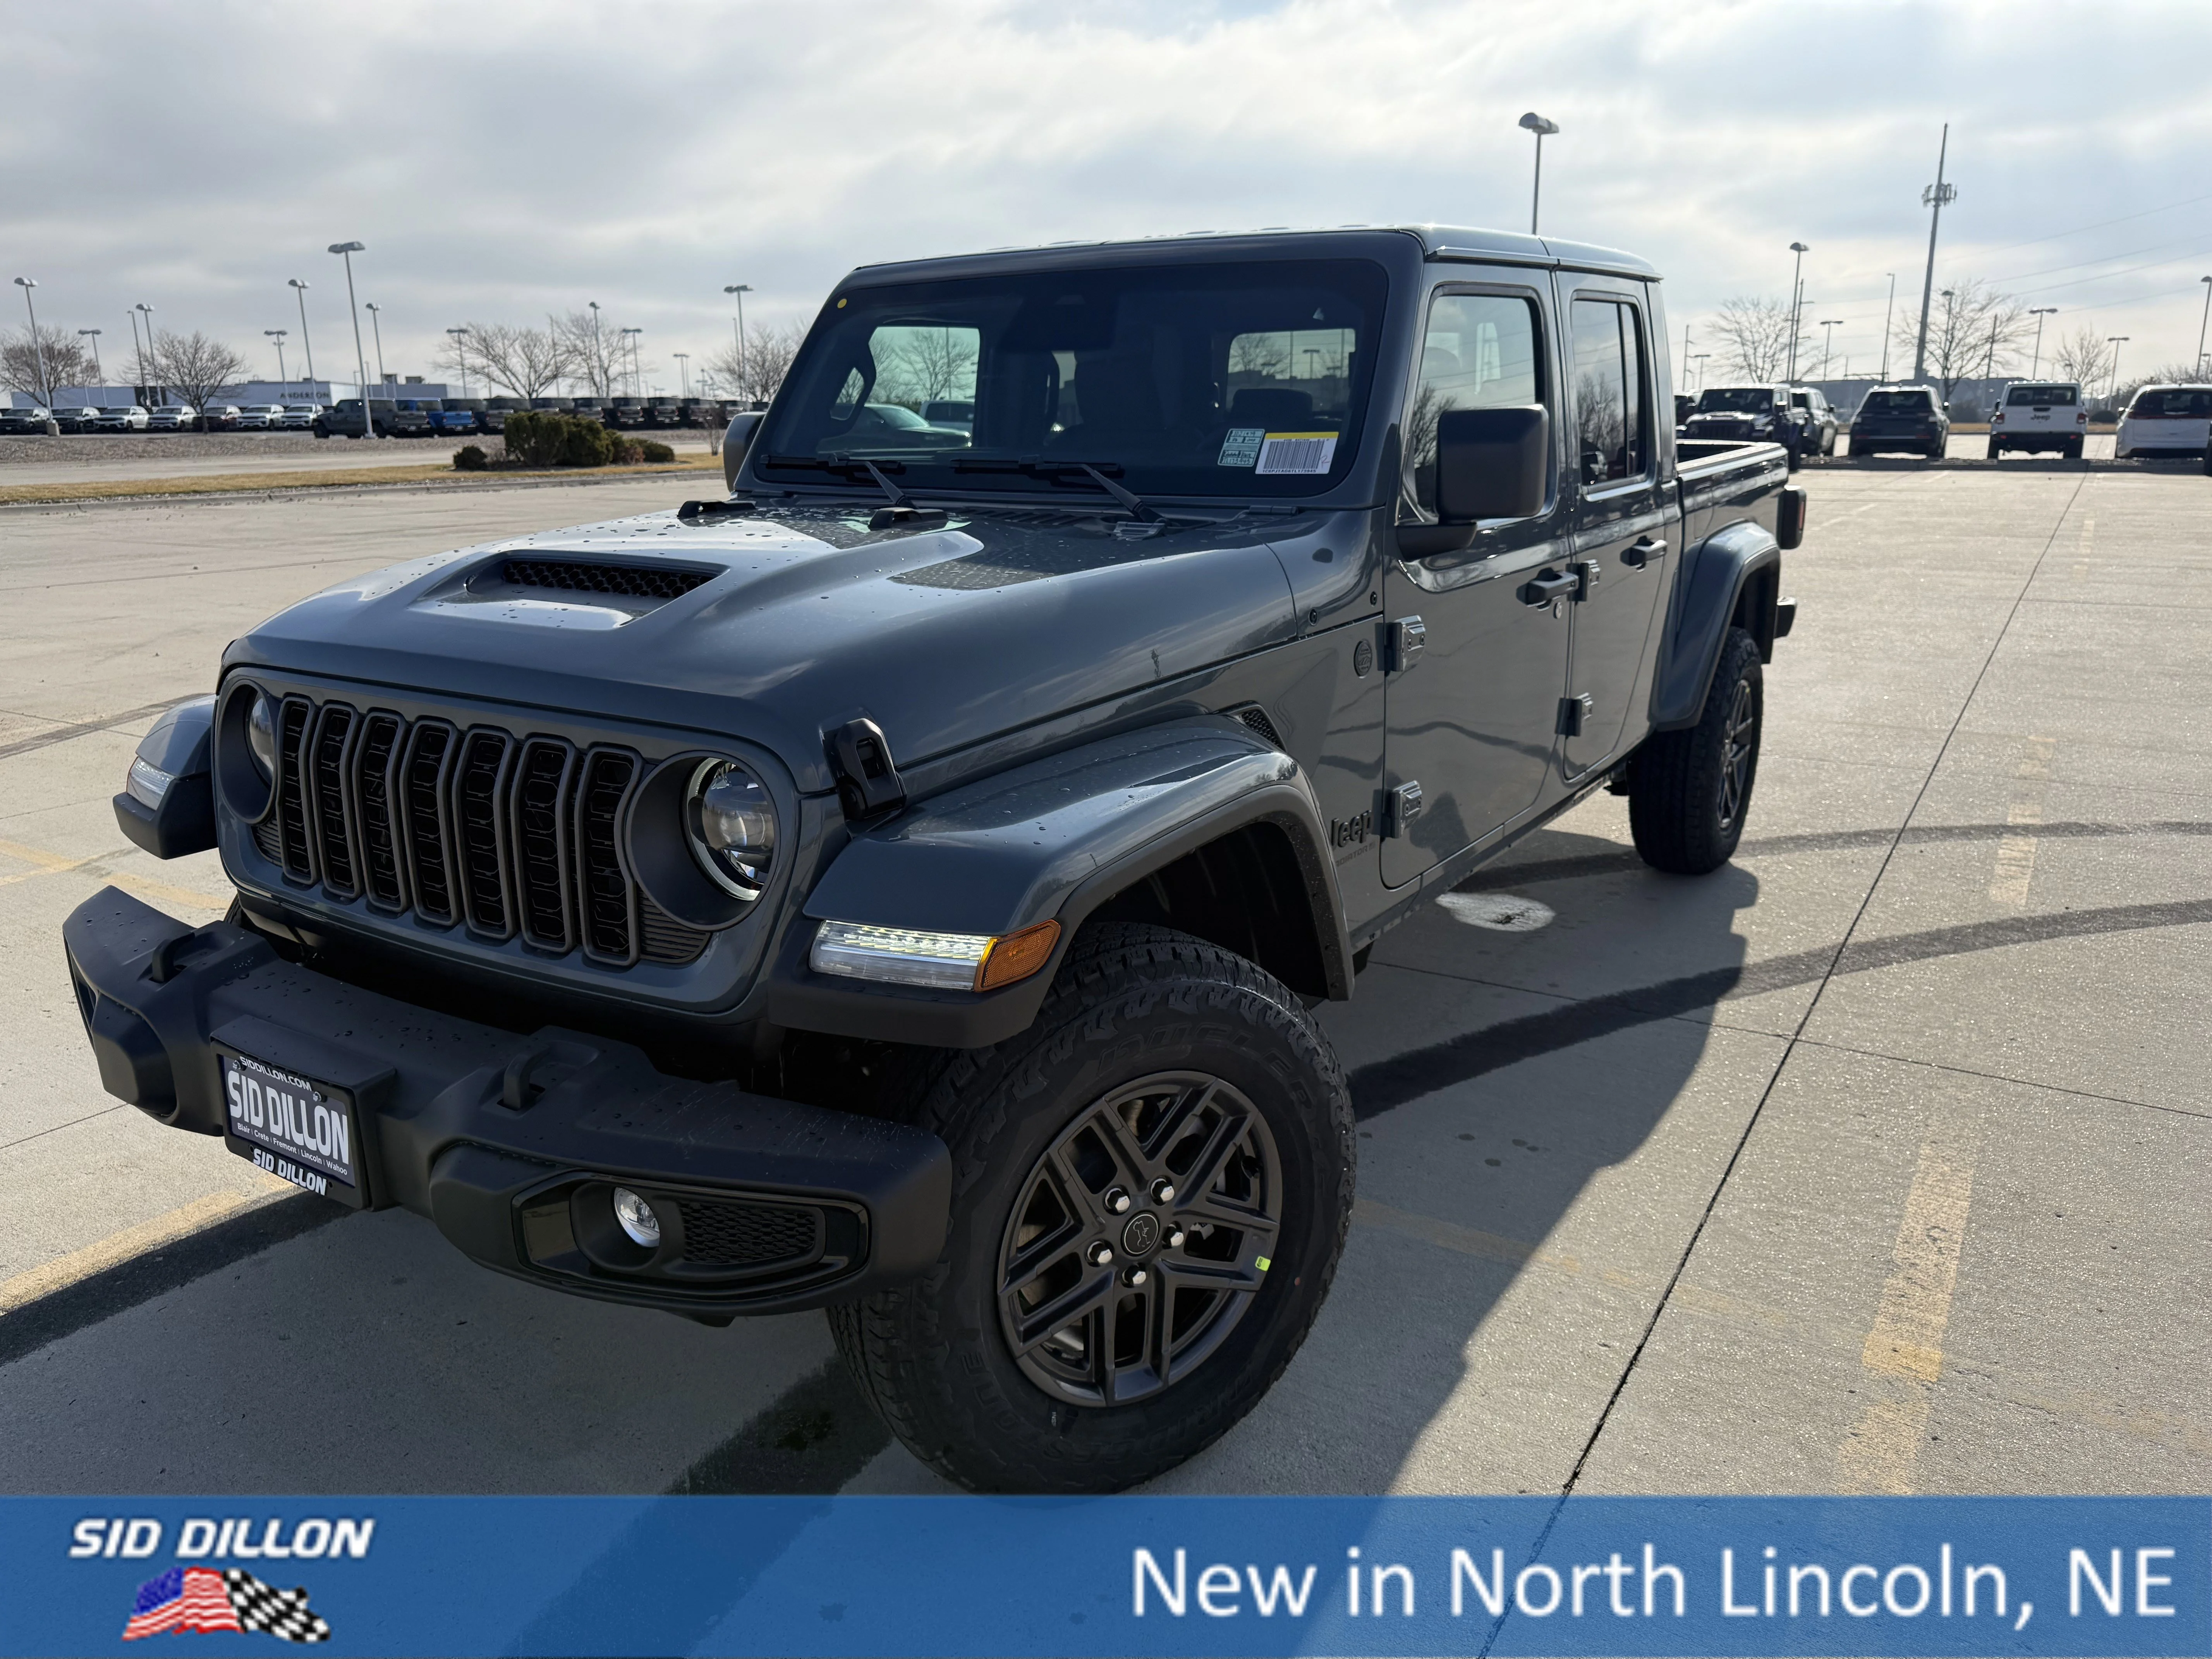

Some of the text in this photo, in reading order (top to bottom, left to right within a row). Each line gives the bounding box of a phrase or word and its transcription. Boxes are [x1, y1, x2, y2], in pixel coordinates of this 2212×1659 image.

[1331, 810, 1374, 848] Jeep
[239, 1055, 312, 1091] SIDDILLON.COM
[228, 1070, 349, 1164] SID DILLON
[237, 1122, 347, 1175] Blair Crete Fremont Lincoln Wahoo
[253, 1148, 327, 1196] SID DILLON
